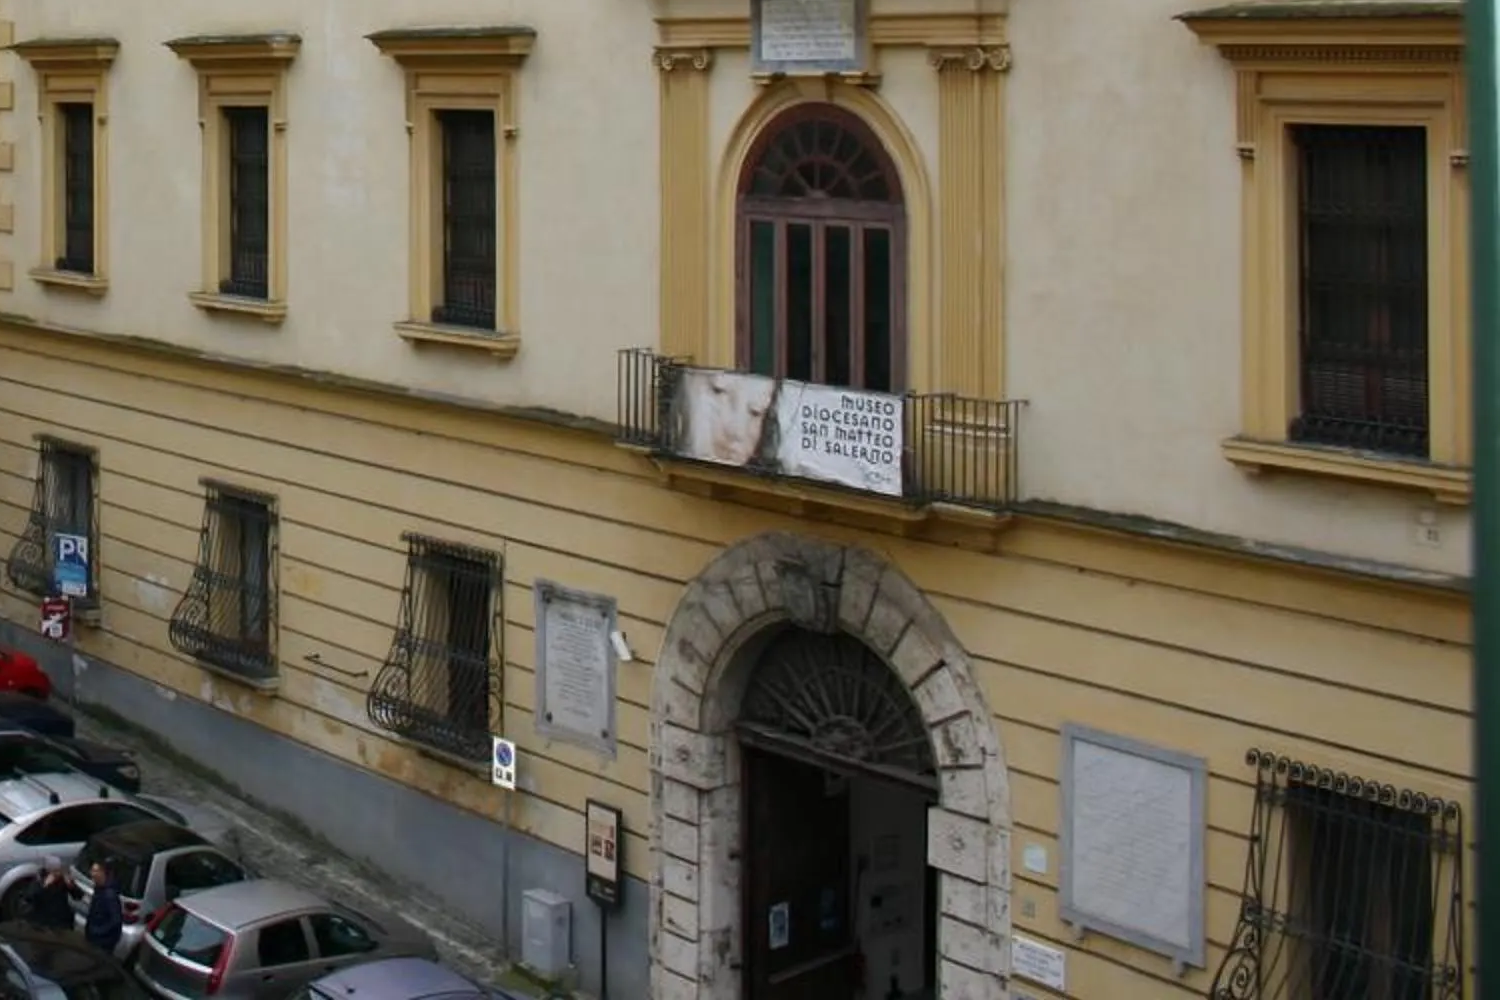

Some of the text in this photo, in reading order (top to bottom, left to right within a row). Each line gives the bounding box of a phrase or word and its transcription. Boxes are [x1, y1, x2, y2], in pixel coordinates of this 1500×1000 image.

[802, 404, 895, 432] DIOCESANO
[841, 394, 895, 416] MUSEO
[801, 421, 894, 448] SAN MATTEO
[801, 435, 894, 465] DI SALERNO
[59, 538, 75, 561] P
